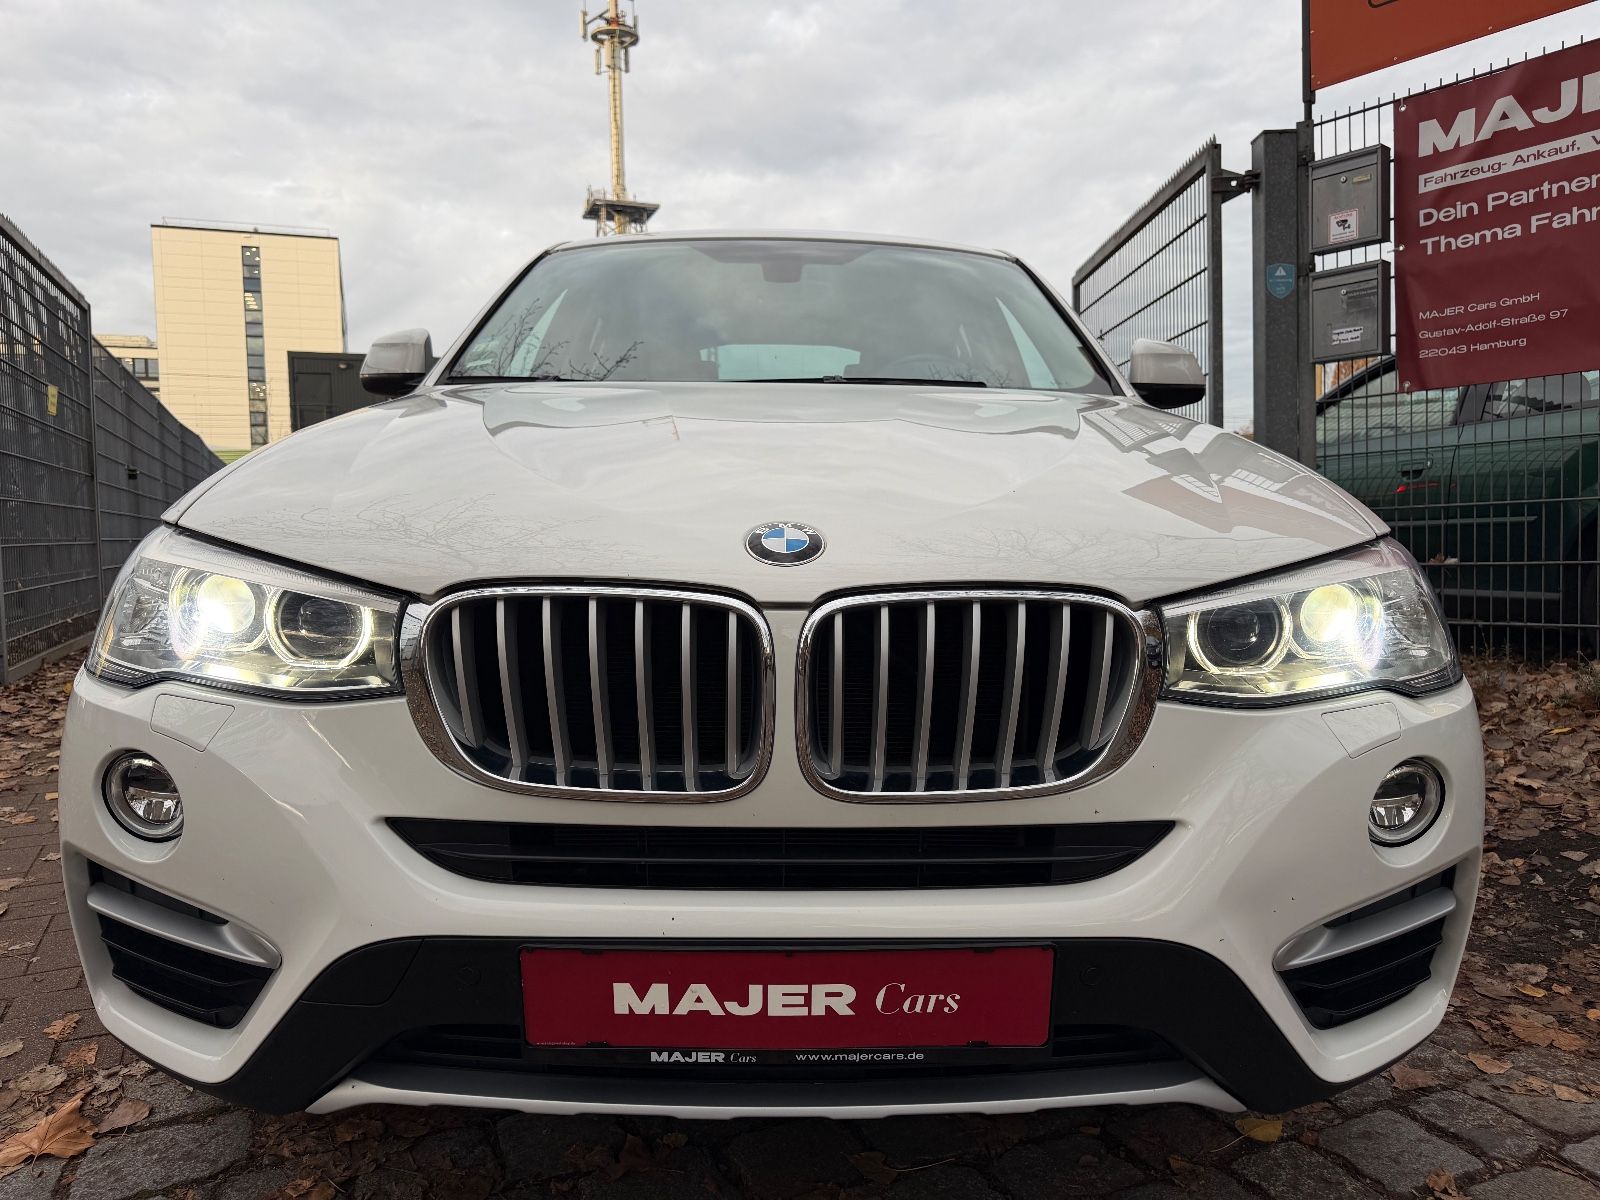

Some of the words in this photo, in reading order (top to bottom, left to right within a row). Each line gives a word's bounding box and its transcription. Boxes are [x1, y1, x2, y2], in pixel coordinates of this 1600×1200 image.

[1423, 161, 1508, 188] Fahrzeug-
[1419, 201, 1479, 228] Dein
[1487, 172, 1600, 212] Partner
[1419, 223, 1522, 255] Thema
[1530, 205, 1600, 234] Fahr
[1418, 305, 1465, 320] MAJER
[1467, 301, 1497, 312] Cars
[1500, 292, 1540, 307] GmbH
[1418, 313, 1546, 339] Gustav-Adolf-Straße
[1549, 308, 1569, 320] 97
[1418, 344, 1467, 359] 22043
[1470, 337, 1527, 353] Hamburg
[612, 982, 857, 1017] MAJER
[875, 982, 961, 1015] Cars
[650, 1051, 725, 1063] MAJER
[730, 1052, 757, 1064] Cars
[795, 1051, 925, 1063] www.majercars.de
